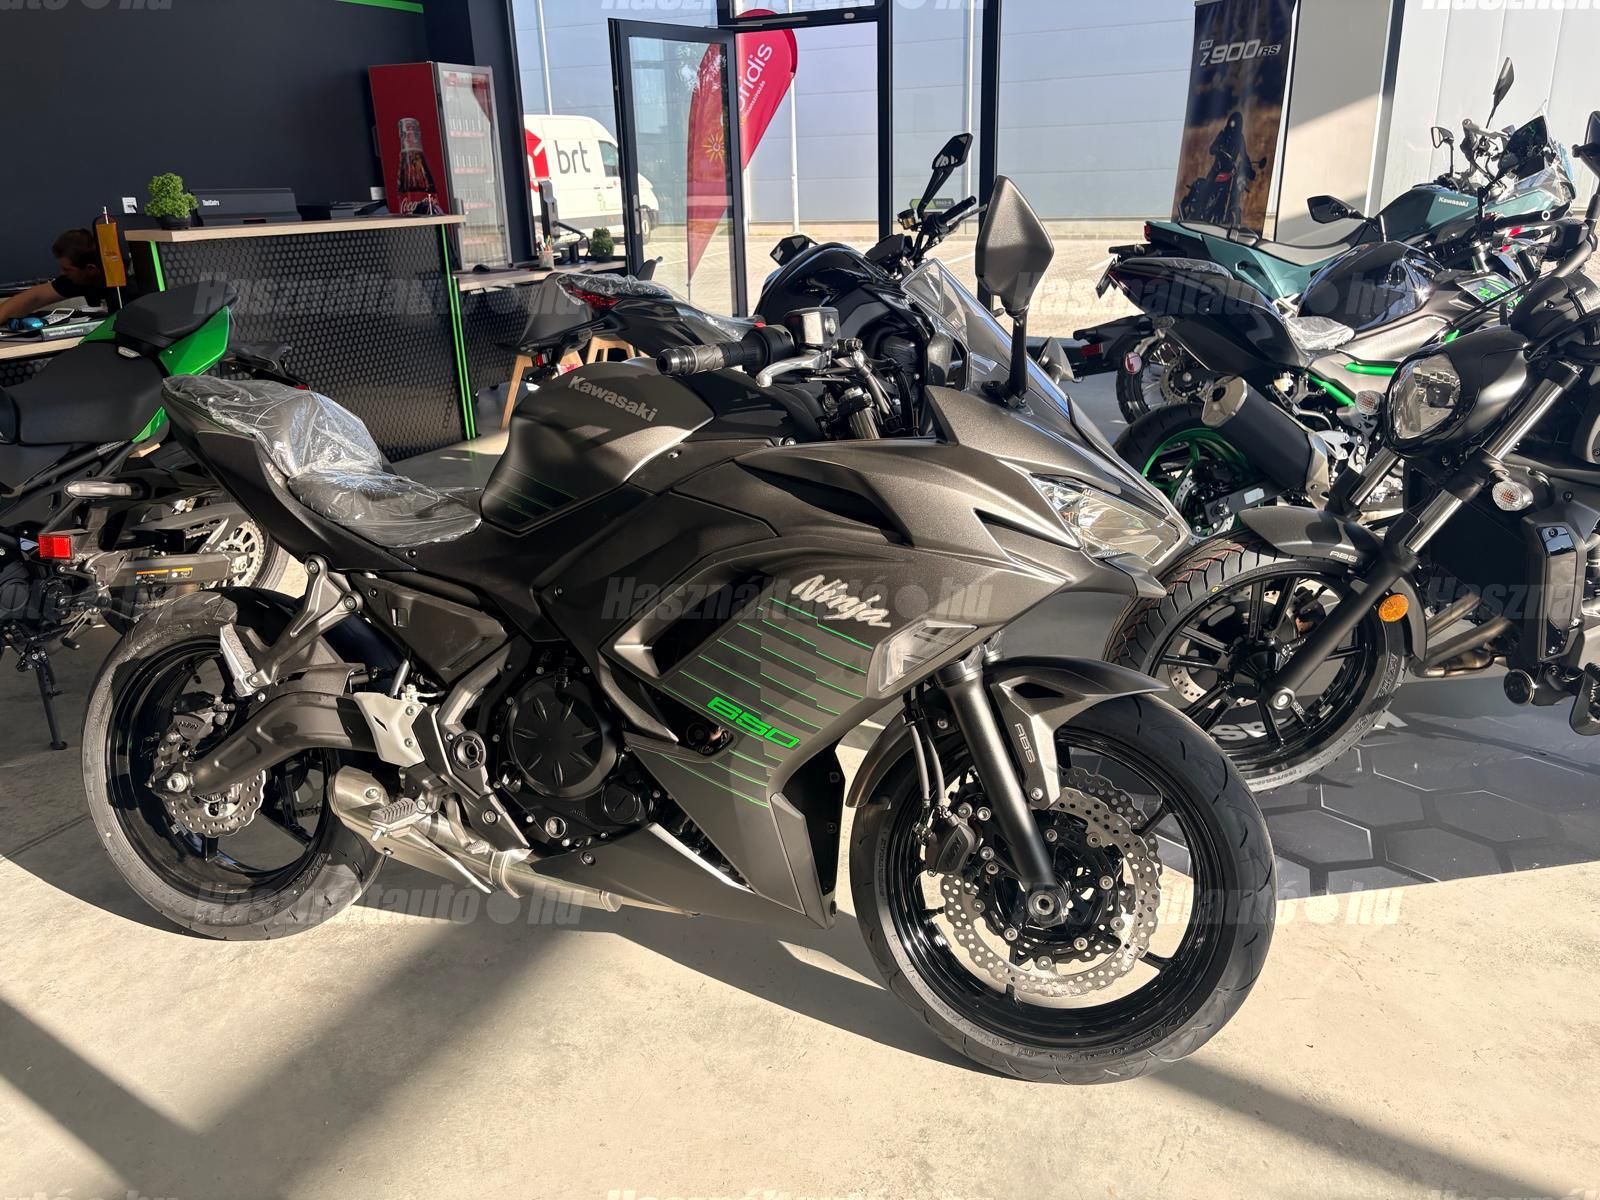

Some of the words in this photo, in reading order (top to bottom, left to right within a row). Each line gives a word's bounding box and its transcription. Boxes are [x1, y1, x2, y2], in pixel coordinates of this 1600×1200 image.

[554, 140, 591, 174] brt
[567, 375, 659, 423] Kawasaki
[1330, 550, 1358, 563] ABS
[791, 574, 892, 629] Ninja
[706, 696, 801, 749] 650
[1014, 722, 1036, 764] ABS
